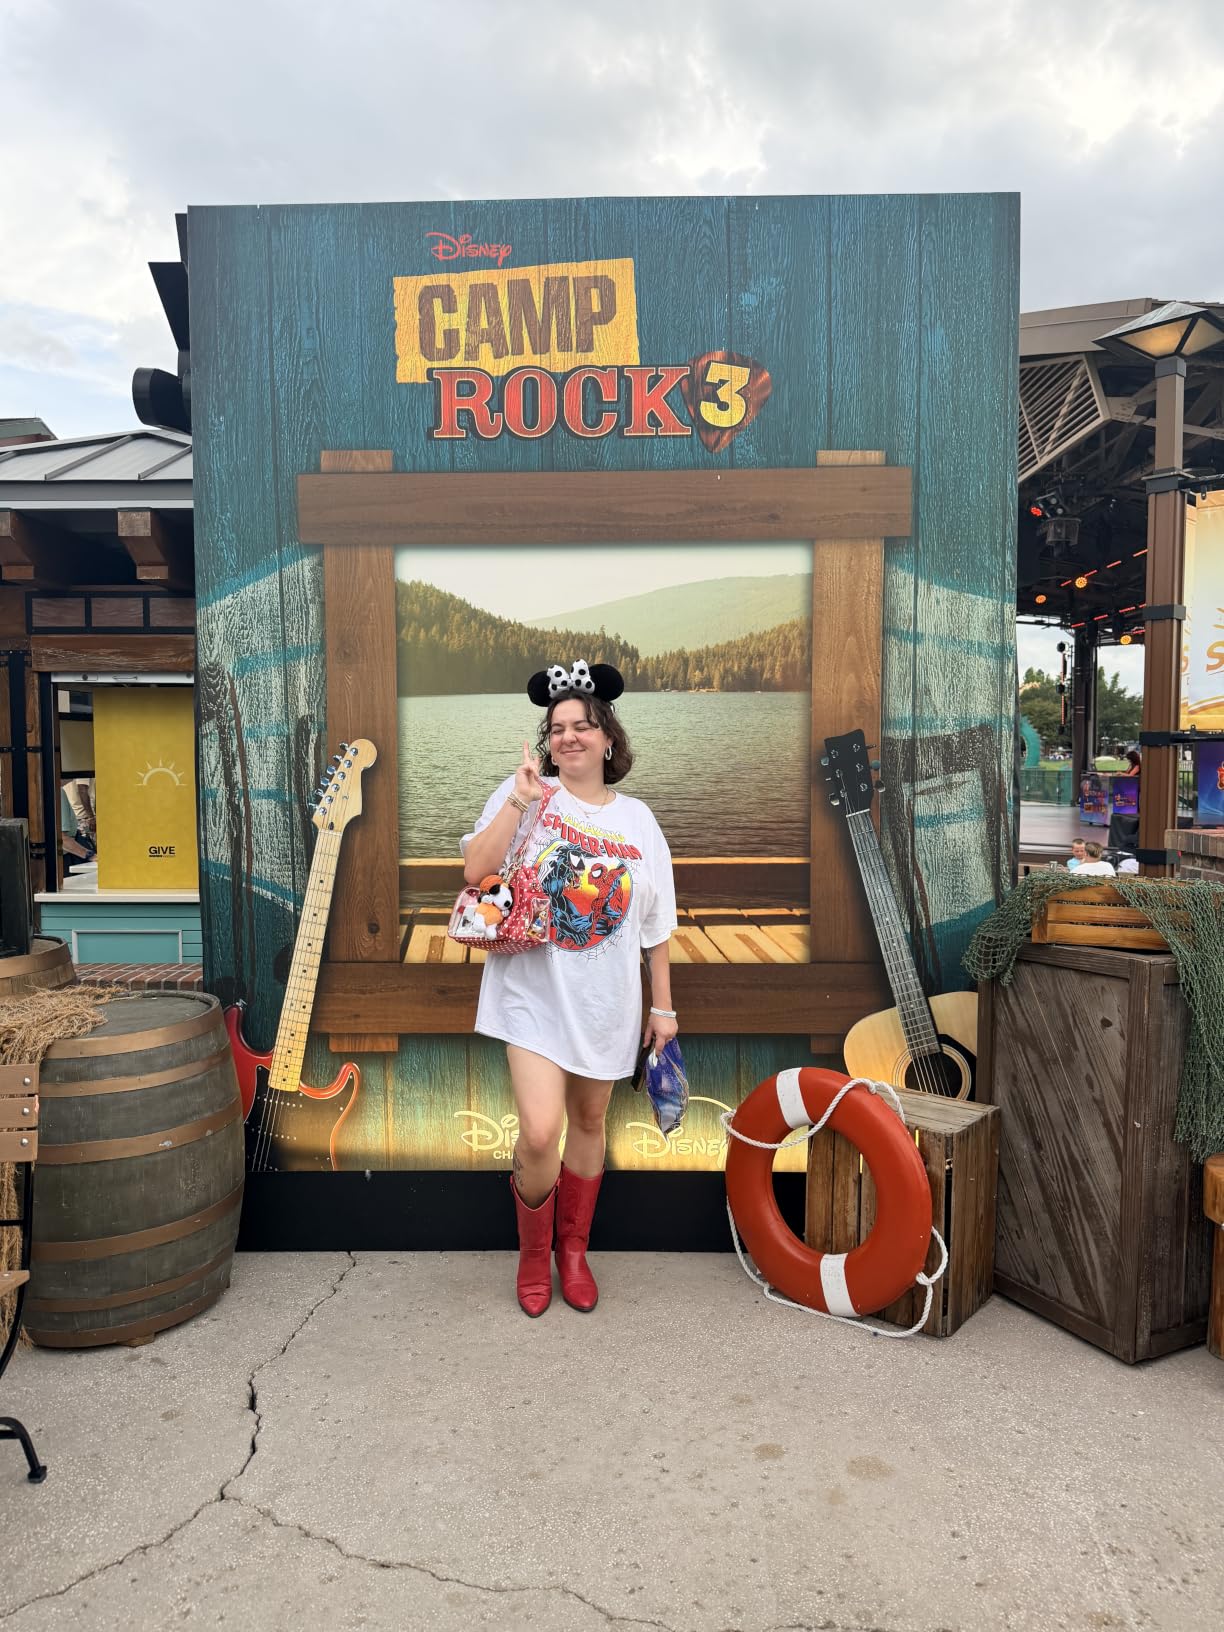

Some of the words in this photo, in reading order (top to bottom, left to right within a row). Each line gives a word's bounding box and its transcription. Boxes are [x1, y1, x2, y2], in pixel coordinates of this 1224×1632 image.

[425, 232, 512, 268] Disney
[417, 275, 617, 362] CAMP
[432, 367, 692, 439] ROCK
[699, 362, 750, 428] 3
[148, 846, 176, 855] GIVE
[542, 813, 643, 861] SPIDER-MAN
